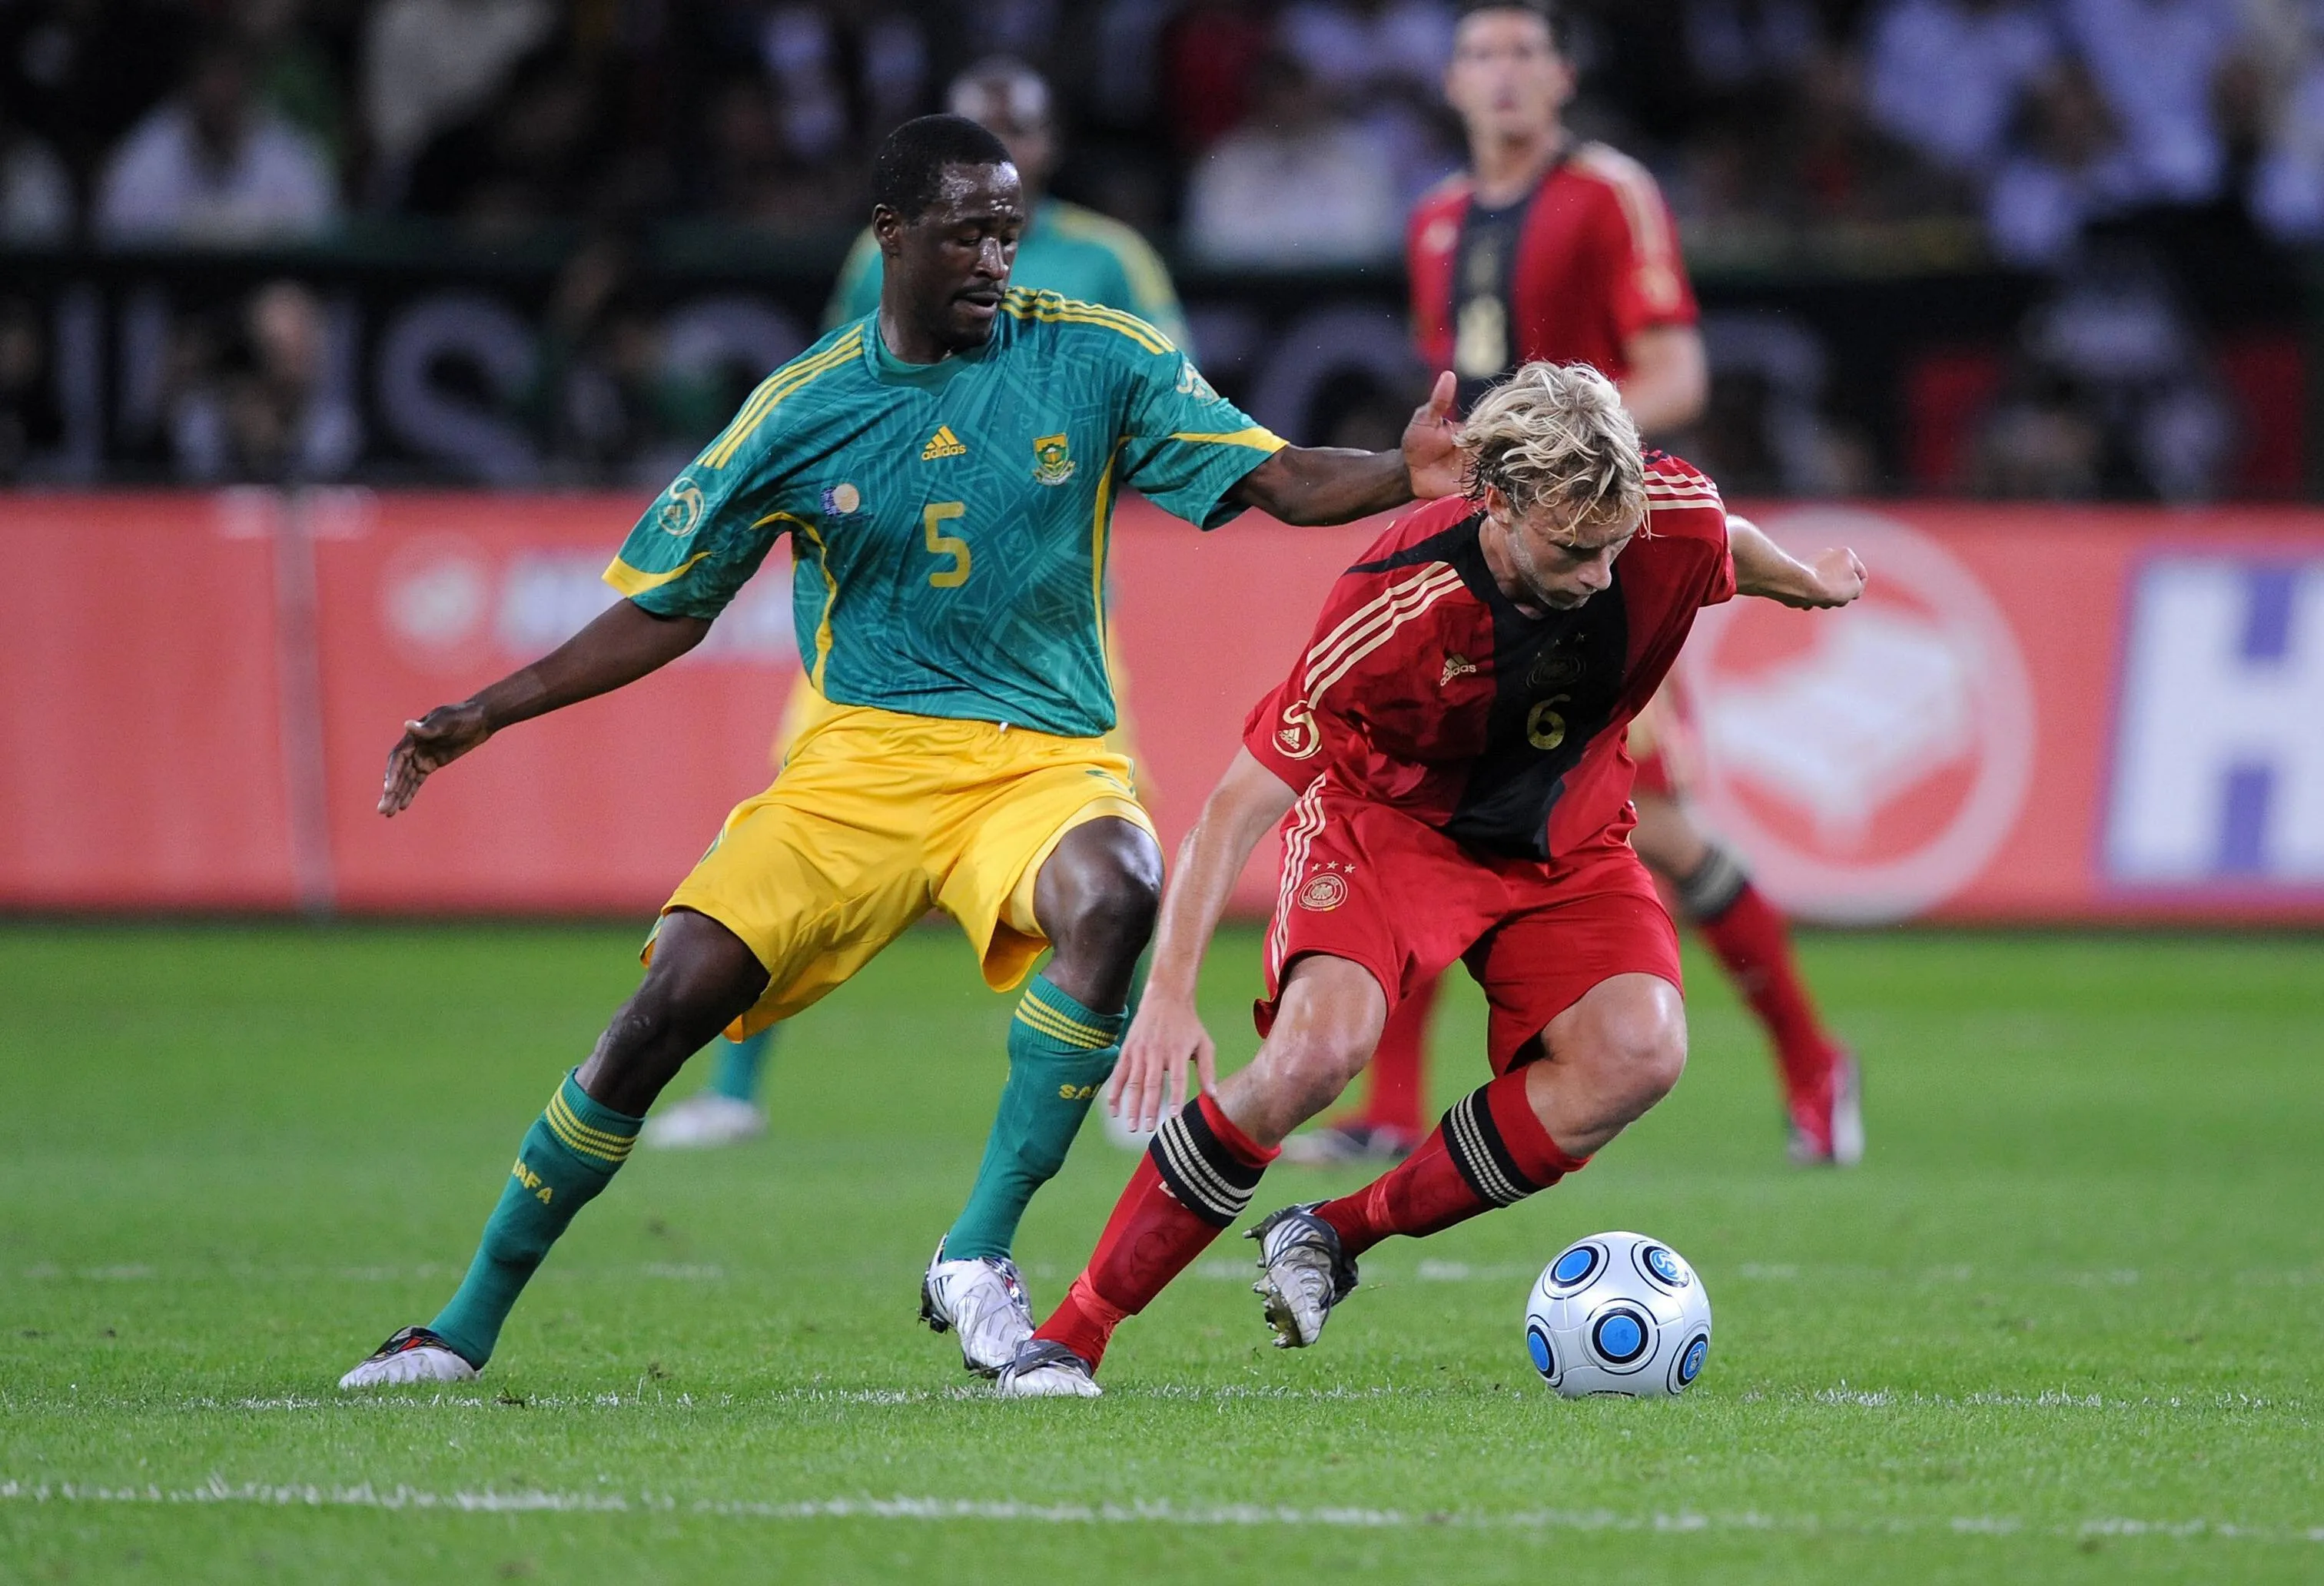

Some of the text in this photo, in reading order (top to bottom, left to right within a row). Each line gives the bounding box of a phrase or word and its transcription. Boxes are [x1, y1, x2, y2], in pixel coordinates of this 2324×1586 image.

[921, 445, 966, 460] adidas
[924, 501, 971, 588] 5
[1527, 694, 1571, 750] 6
